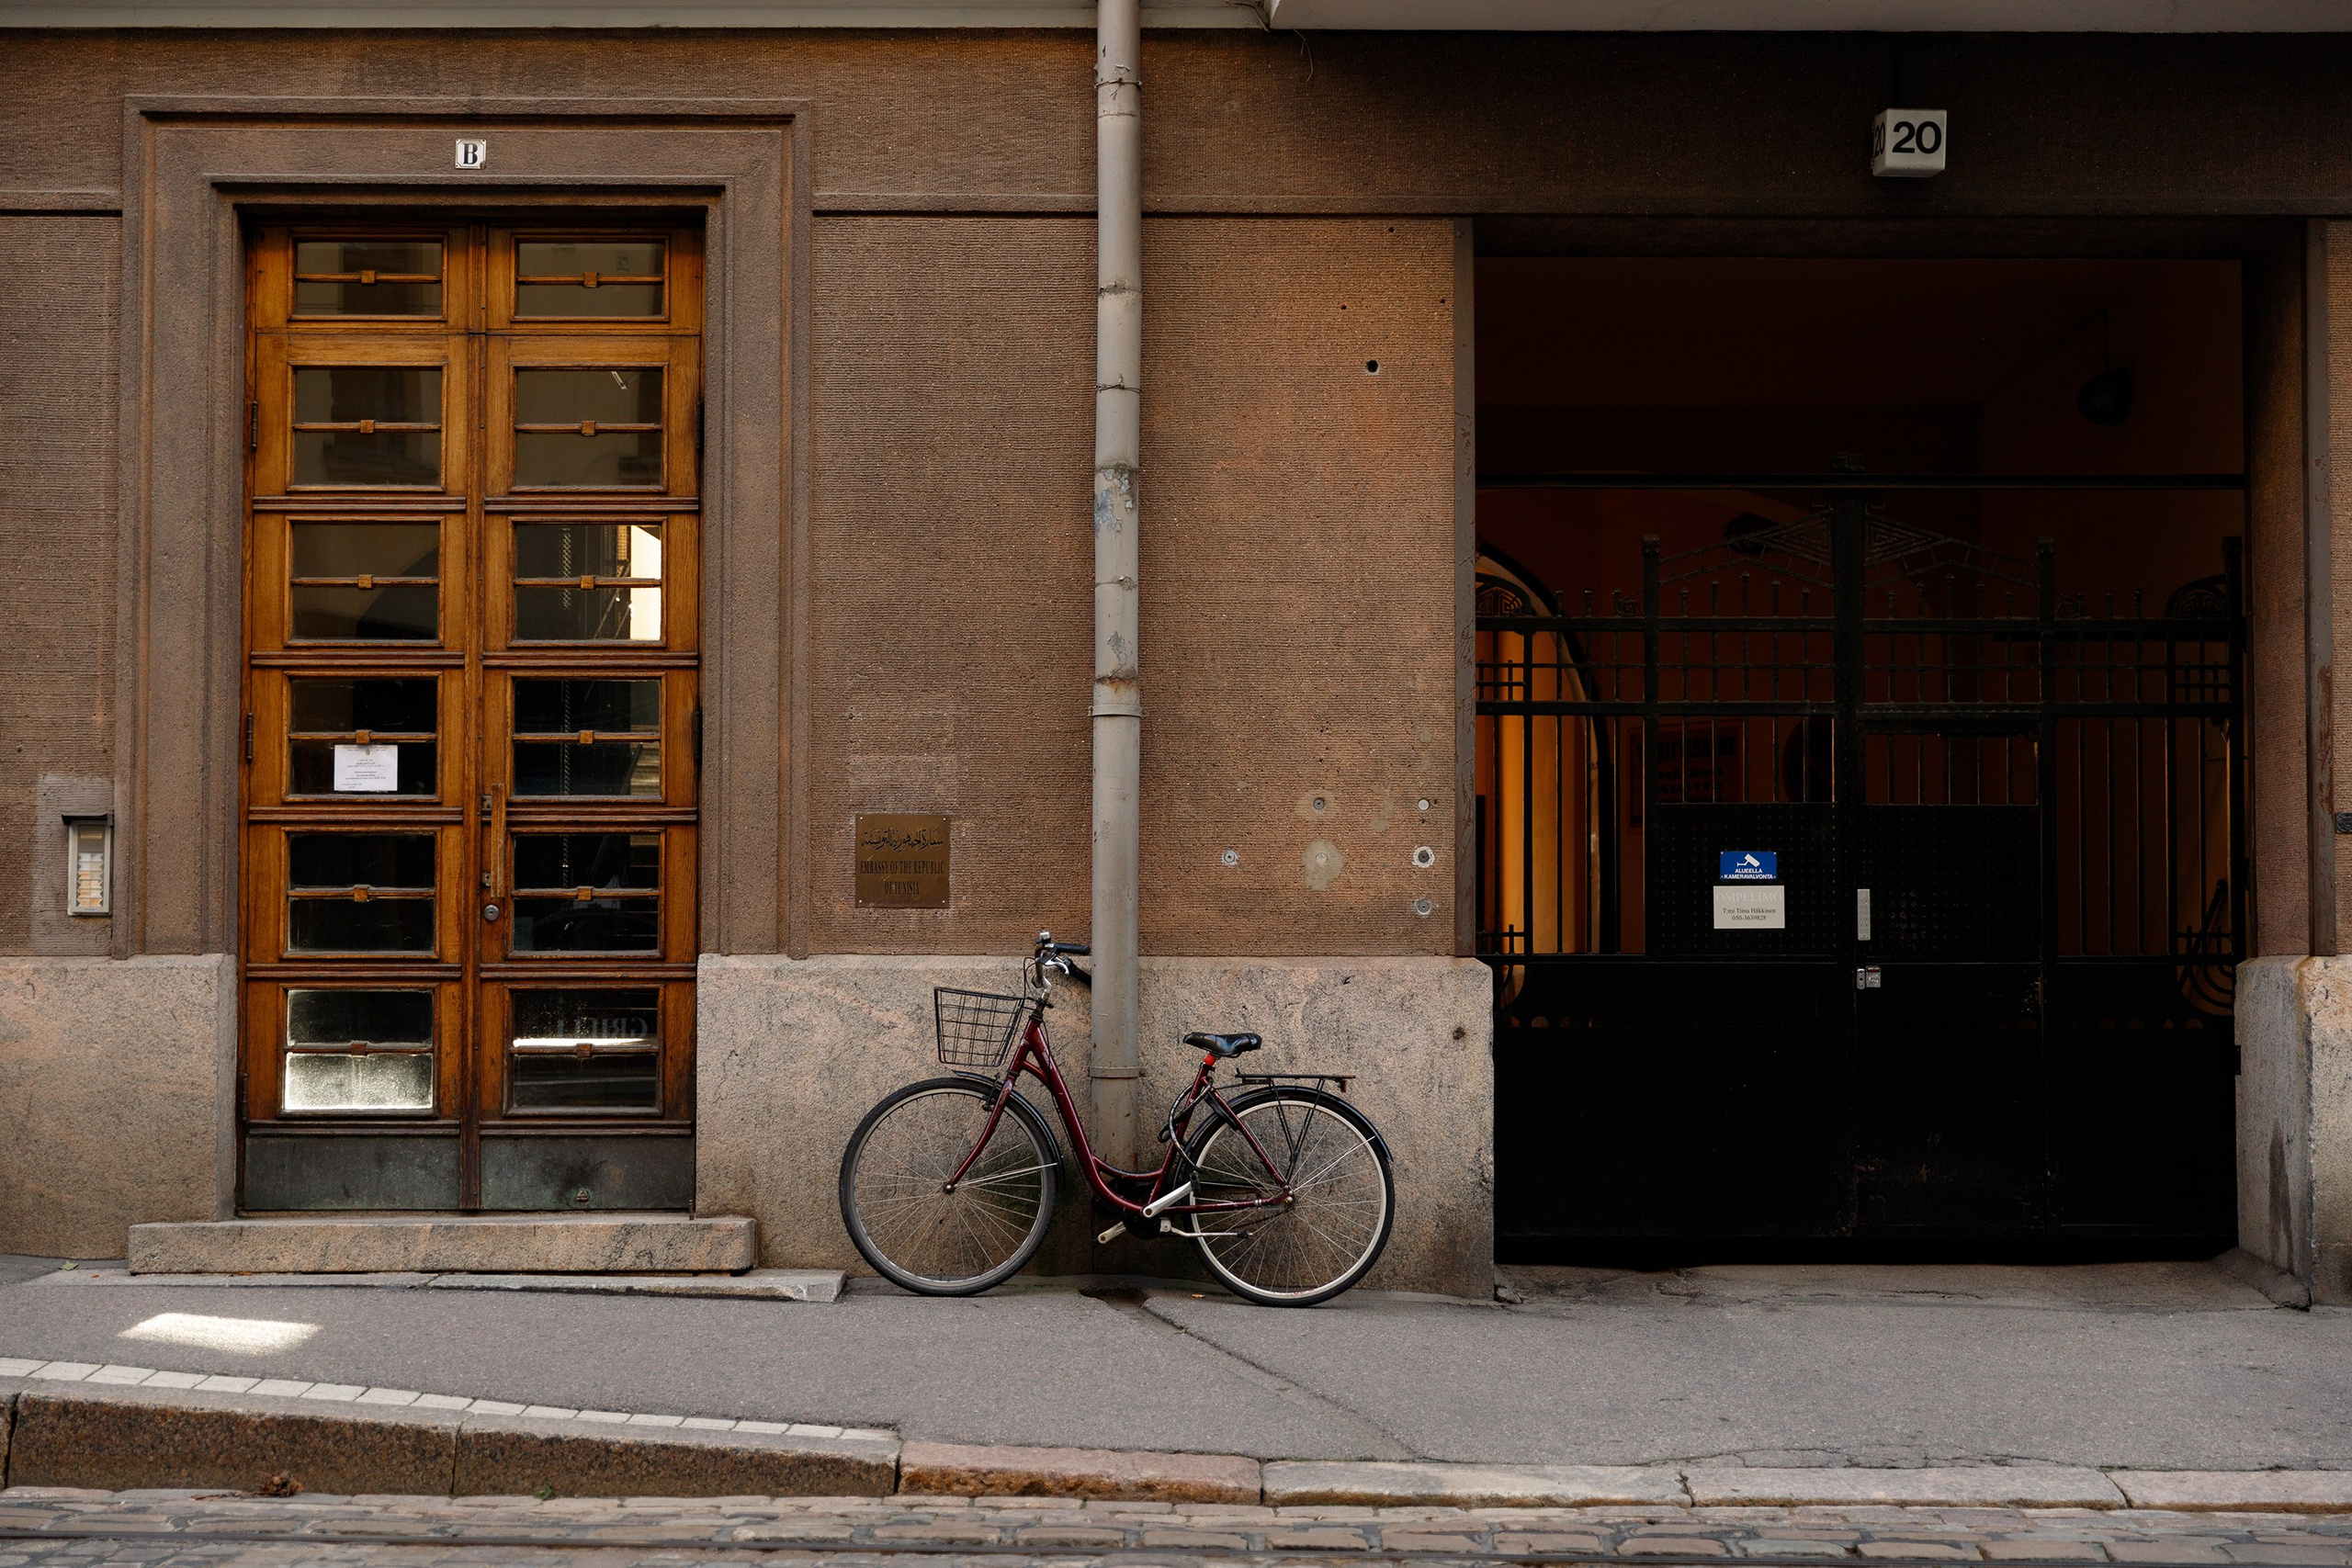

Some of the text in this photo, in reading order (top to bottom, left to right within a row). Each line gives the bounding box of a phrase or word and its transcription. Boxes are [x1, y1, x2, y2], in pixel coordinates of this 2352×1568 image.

[1892, 121, 1941, 154] 20
[462, 142, 479, 165] B
[860, 861, 944, 874] EMBASSY OF THE REPUBLIC
[885, 881, 920, 896] OF TUNISIA
[1715, 892, 1782, 902] OMPELIMO
